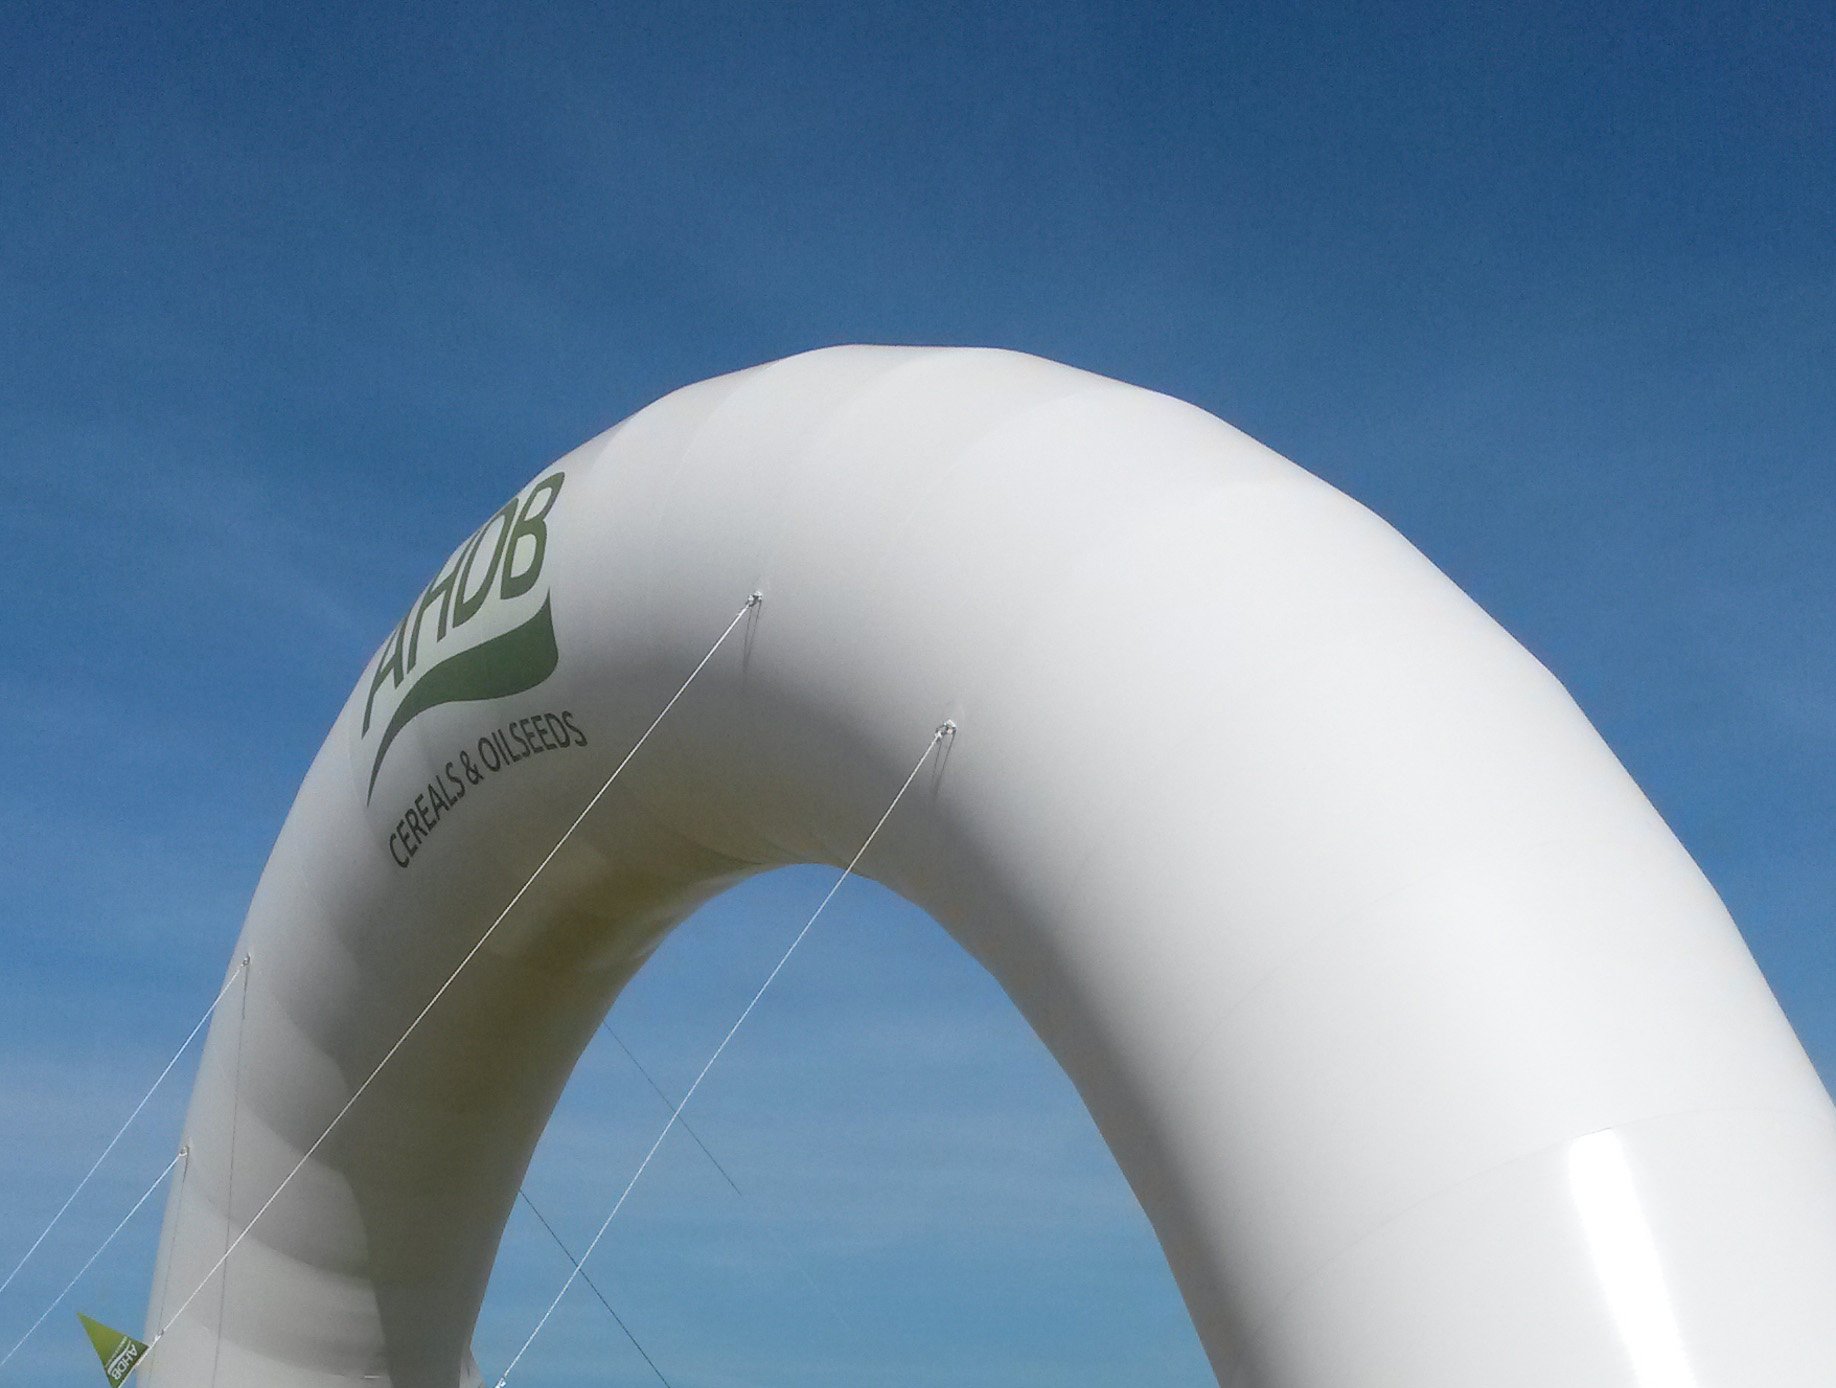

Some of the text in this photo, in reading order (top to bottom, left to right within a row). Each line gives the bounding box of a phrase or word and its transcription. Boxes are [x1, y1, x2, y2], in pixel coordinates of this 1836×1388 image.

[362, 471, 565, 740] AHDB
[389, 710, 589, 869] CEREALS & OILSEEDS
[111, 1344, 138, 1381] AHDB
